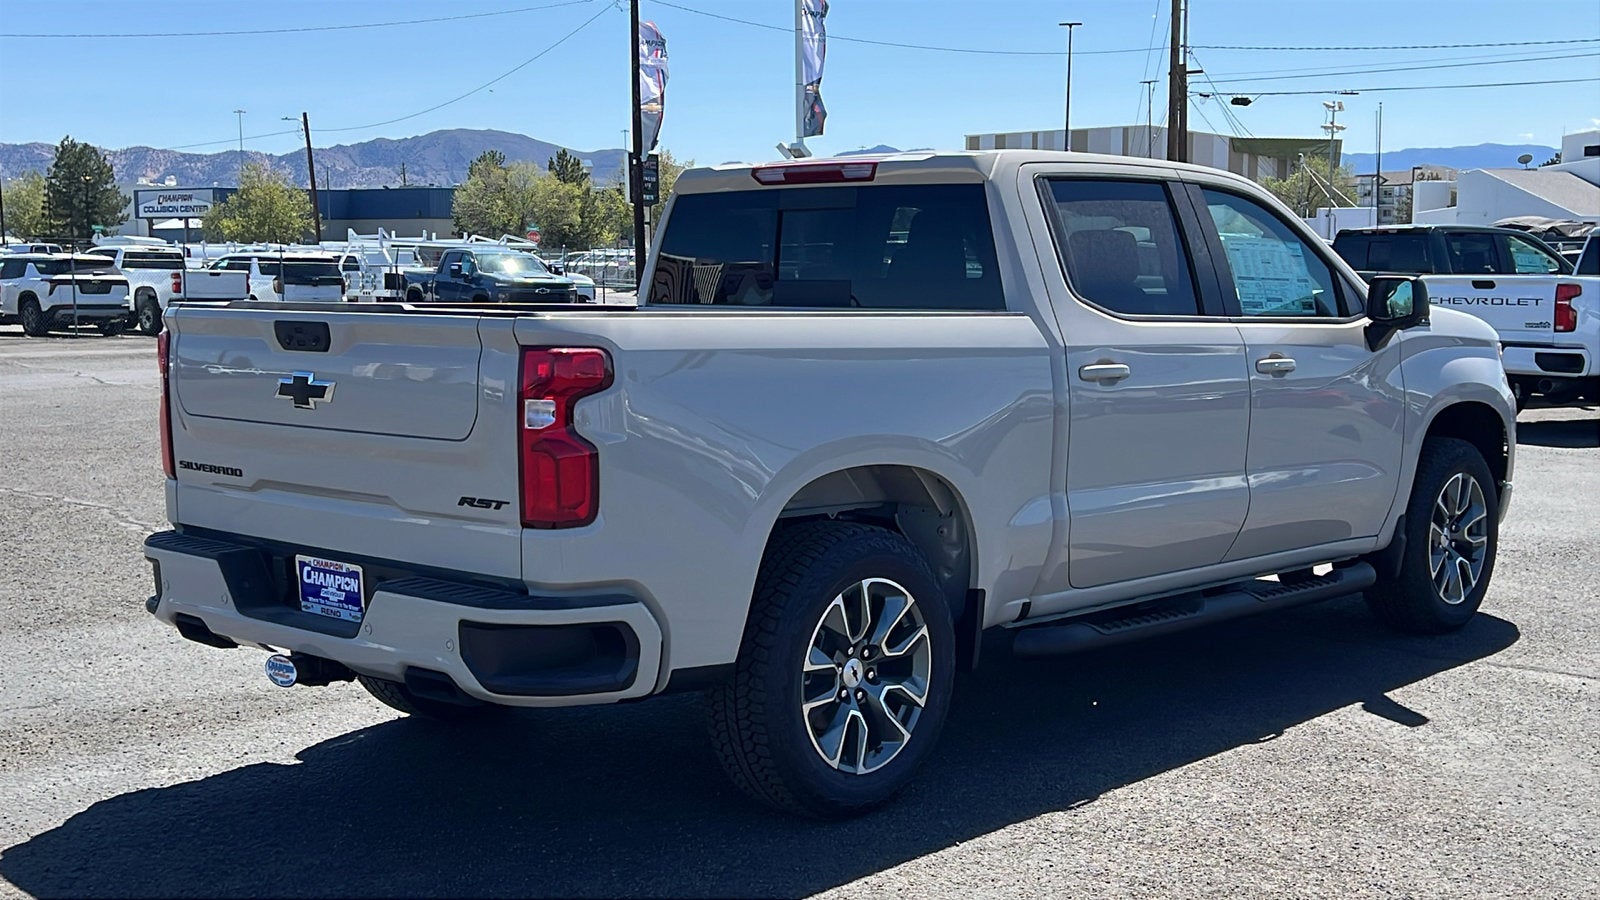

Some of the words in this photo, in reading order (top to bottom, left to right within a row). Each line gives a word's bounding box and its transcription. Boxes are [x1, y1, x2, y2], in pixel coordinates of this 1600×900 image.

[157, 193, 193, 205] CHAMPION
[143, 205, 179, 213] COLLISION
[1429, 297, 1543, 306] CHEVROLET
[179, 460, 243, 477] SILVERADO
[457, 496, 510, 510] RST
[313, 559, 344, 571] CHAMPION
[302, 566, 358, 593] CHAMPION
[320, 607, 342, 617] RENO
